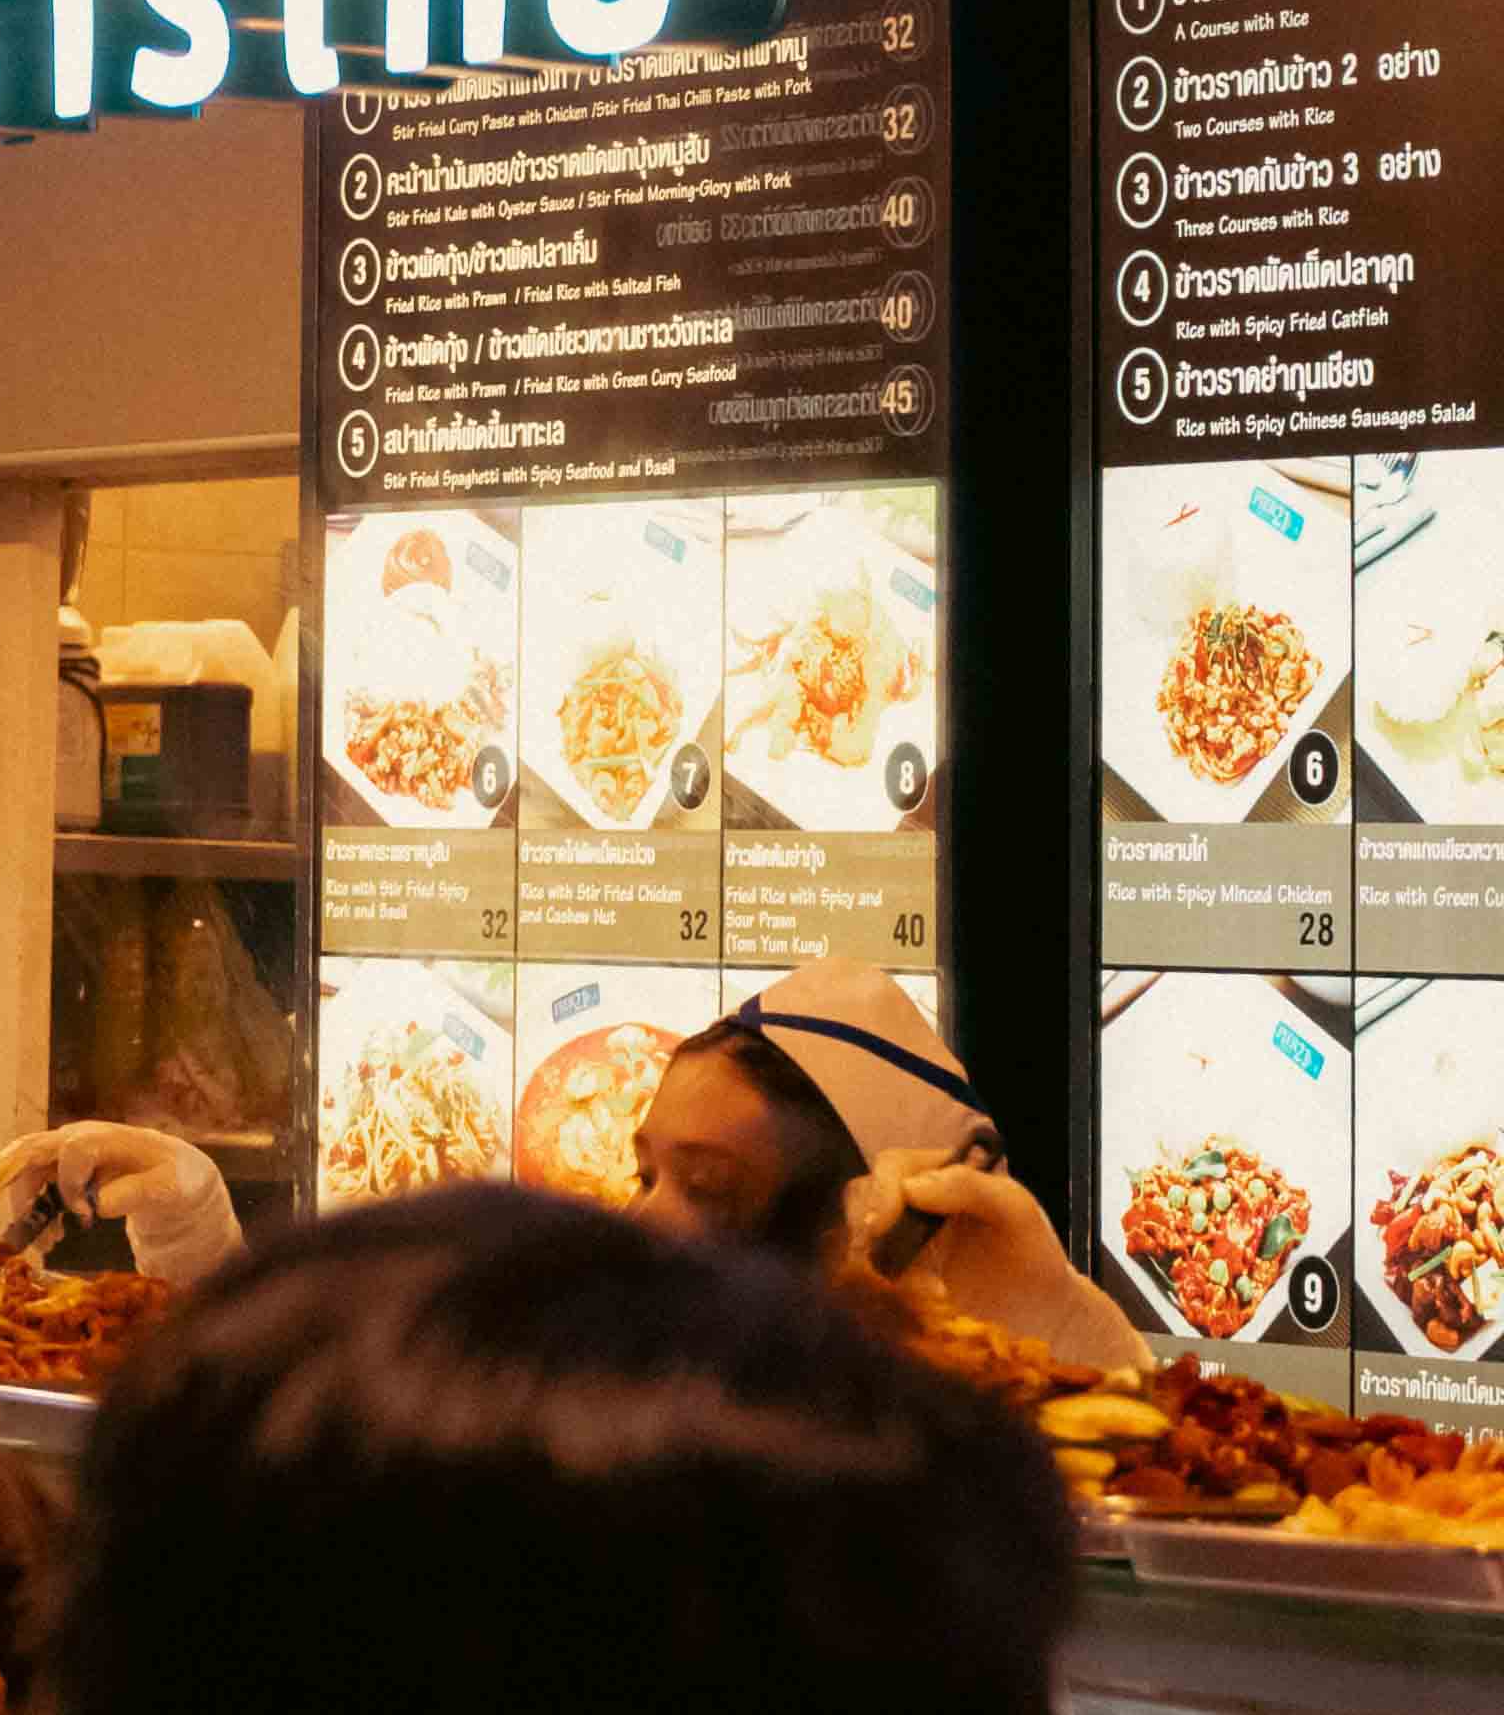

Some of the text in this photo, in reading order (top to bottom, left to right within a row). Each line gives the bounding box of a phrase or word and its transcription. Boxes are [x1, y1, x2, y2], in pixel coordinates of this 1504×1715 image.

[882, 14, 915, 52] 32
[1175, 10, 1310, 41] A Course with Rice
[1133, 42, 1440, 109] 2 ข้าวราดกับข้าว 2 อย่าง
[393, 124, 415, 141] Stir
[418, 120, 446, 138] Fried
[449, 116, 478, 136] Curry
[482, 114, 515, 131] Paste
[518, 110, 542, 128] with
[546, 105, 587, 123] Chicken
[624, 96, 652, 114] Fried
[656, 93, 681, 109] Thai
[716, 86, 751, 104] Paste
[755, 82, 781, 99] with
[785, 77, 813, 96] Pork
[883, 105, 915, 142] 32
[1175, 106, 1335, 139] Two Courses with Rice
[354, 171, 368, 200] 2
[1134, 142, 1441, 205] 3 ข้าวราดกับข้าว 3 อย่าง
[387, 172, 791, 229] Stir Fried Kale with Oyster Sauce Stir Fried Morning-Glory with Pork
[881, 194, 914, 228] 40
[1176, 206, 1349, 238] Three Courses with Rice
[353, 256, 367, 285] 3
[1134, 271, 1150, 303] 4
[386, 274, 681, 314] Fried Rice with Prawn Fried Rice with Salted Fish
[881, 295, 913, 330] 40
[1176, 306, 1389, 341] Rice with Spicy Fried Catfish
[352, 342, 366, 370] 4
[385, 364, 736, 404] Fried Rice with Prawn Fried Rice with Green Curry Seafood
[880, 380, 913, 413] 45
[1134, 368, 1150, 400] 5
[1176, 401, 1476, 440] Rice with Spicy Chinese Sausages Salad
[351, 428, 365, 457] 5
[384, 457, 675, 492] Stir Fried Spaghetti with Spicy Seafood and Basil
[899, 761, 914, 793] 8
[1306, 750, 1323, 786] 6
[1108, 882, 1333, 909] Rice with Spicy Minced Chicken
[1360, 885, 1480, 907] Rice with Green
[481, 908, 509, 940] 32
[679, 909, 709, 941] 32
[893, 913, 925, 947] 40
[1298, 911, 1335, 947] 28
[1304, 1272, 1323, 1313] 9
